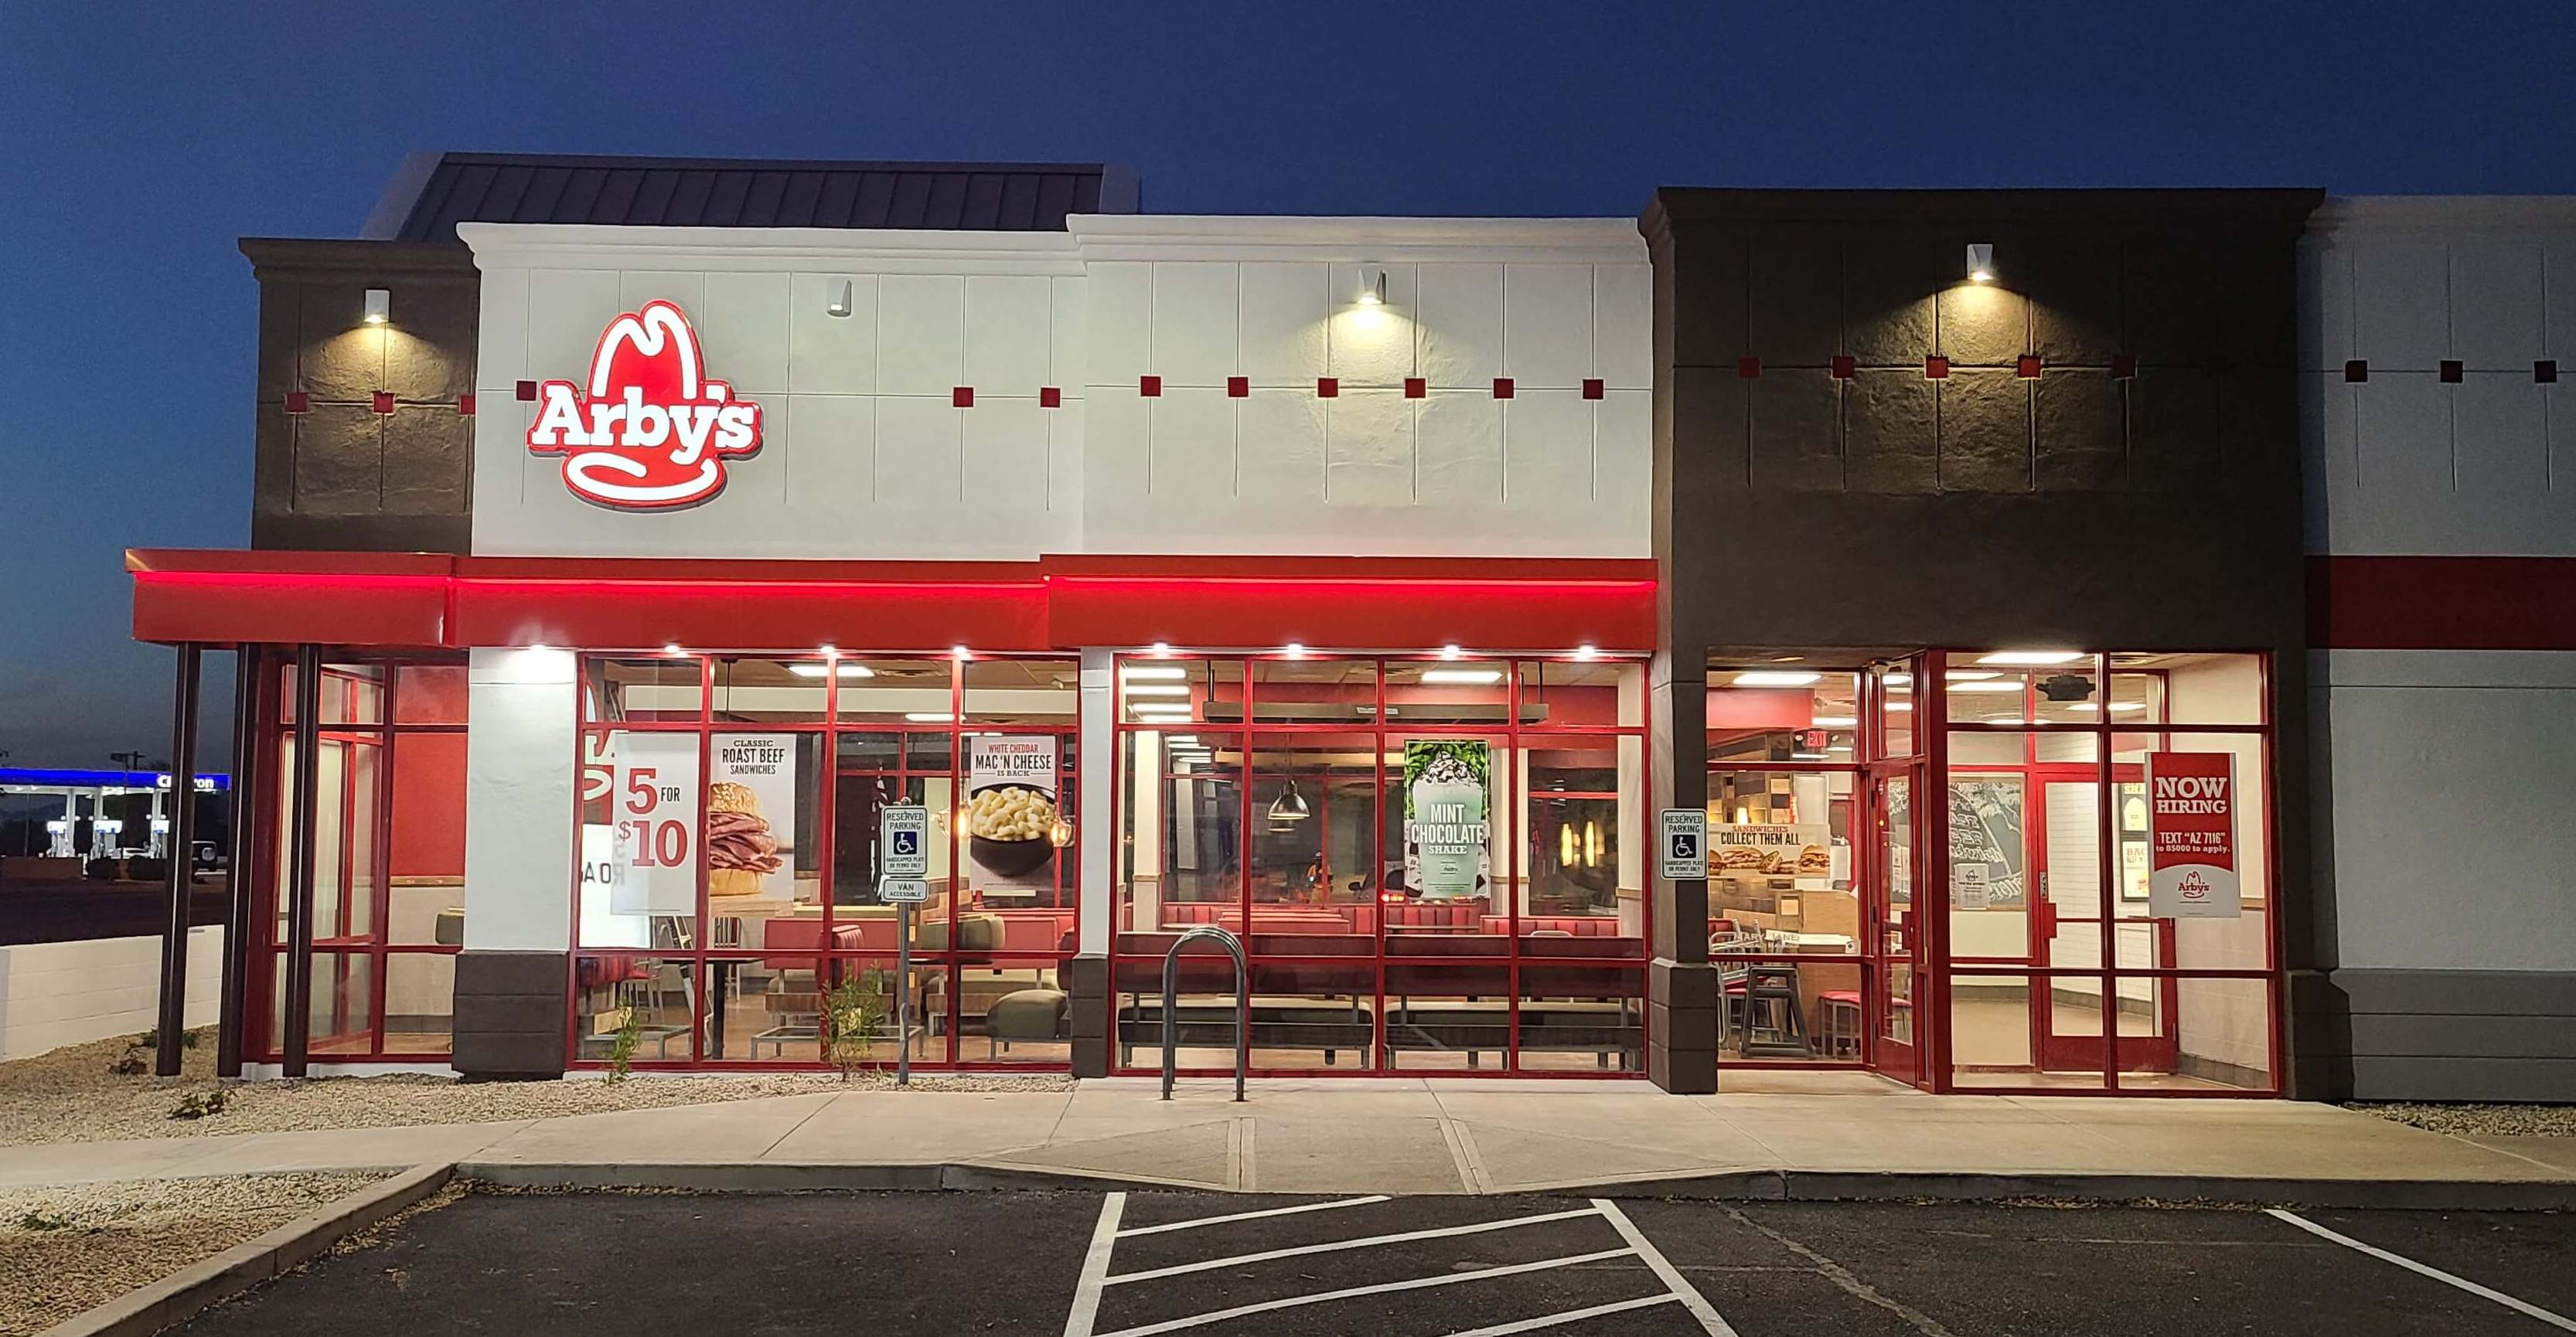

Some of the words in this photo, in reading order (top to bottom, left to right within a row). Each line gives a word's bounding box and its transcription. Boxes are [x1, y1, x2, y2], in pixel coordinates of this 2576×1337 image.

[531, 385, 754, 464] Arby's
[1808, 730, 1827, 747] EXIT
[988, 743, 1008, 754] WHITE
[1010, 743, 1039, 754] CHEDDAR
[722, 748, 757, 764] ROAST
[759, 748, 785, 764] BEEF
[975, 754, 998, 770] MAC
[1014, 754, 1052, 770] CHEESE
[730, 764, 776, 775] SANDWICHES
[625, 768, 658, 815] 5
[660, 786, 681, 802] FOR
[2155, 777, 2227, 798] NOW
[1430, 803, 1465, 824] MINT
[2156, 800, 2227, 814] HIRING
[886, 812, 924, 822] RESERVED
[1665, 815, 1703, 824] RESERVED
[889, 822, 922, 830] PARKING
[1668, 825, 1701, 833] PARKING
[1411, 824, 1484, 844] CHOCOLATE
[1720, 832, 1757, 845] COLLECT
[1759, 832, 1783, 845] THEM
[1784, 832, 1801, 845] ALL
[2159, 832, 2182, 844] TEXT
[618, 819, 688, 867] $10
[2203, 845, 2230, 854] apply.
[1428, 845, 1467, 855] SHAKE
[2178, 882, 2210, 893] Arby's
